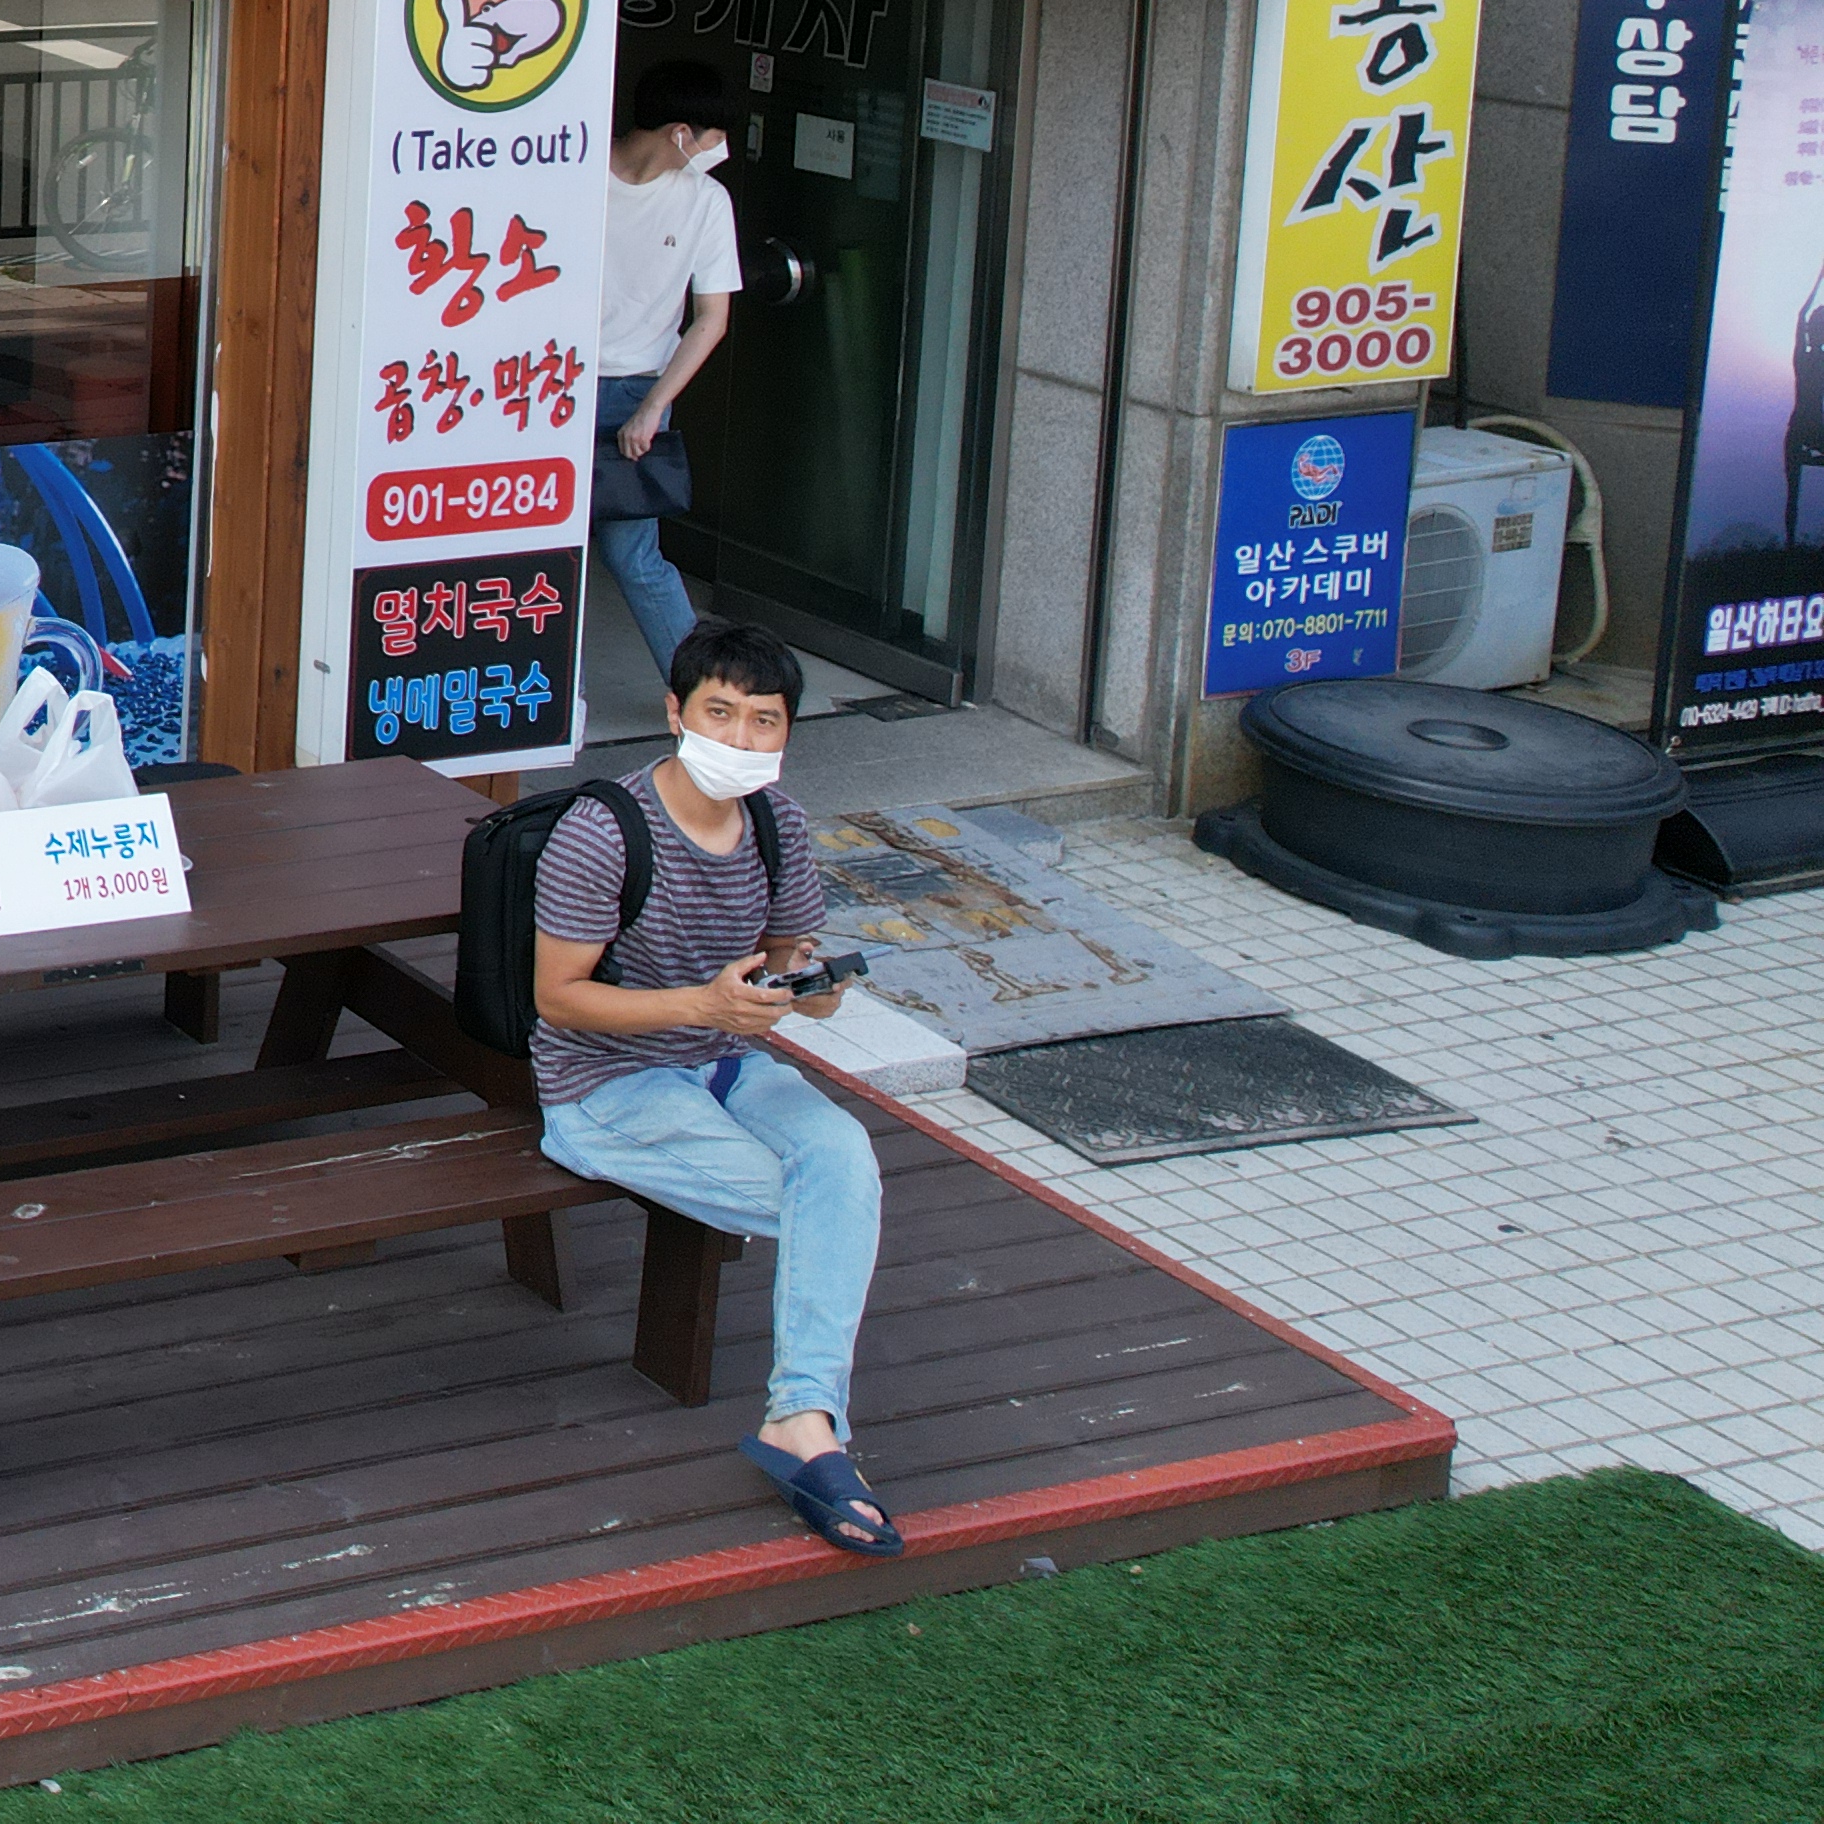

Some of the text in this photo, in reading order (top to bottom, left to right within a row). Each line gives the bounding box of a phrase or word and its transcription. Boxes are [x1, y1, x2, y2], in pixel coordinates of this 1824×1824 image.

[392, 120, 589, 175] (Take out)
[395, 199, 561, 327] 황소
[1296, 284, 1432, 330] 905-
[1279, 331, 1430, 375] 3000
[382, 472, 559, 526] 901-9284
[1289, 503, 1338, 527] PADI
[1236, 530, 1388, 575] 일산 스쿠버
[1246, 567, 1372, 608] 아카데미
[373, 572, 564, 656] 멸치국수
[1285, 647, 1321, 672] 3F
[368, 660, 553, 746] 냉메밀국수
[44, 820, 160, 864] 수제누룽지
[64, 867, 169, 902] 1개 3,000원
